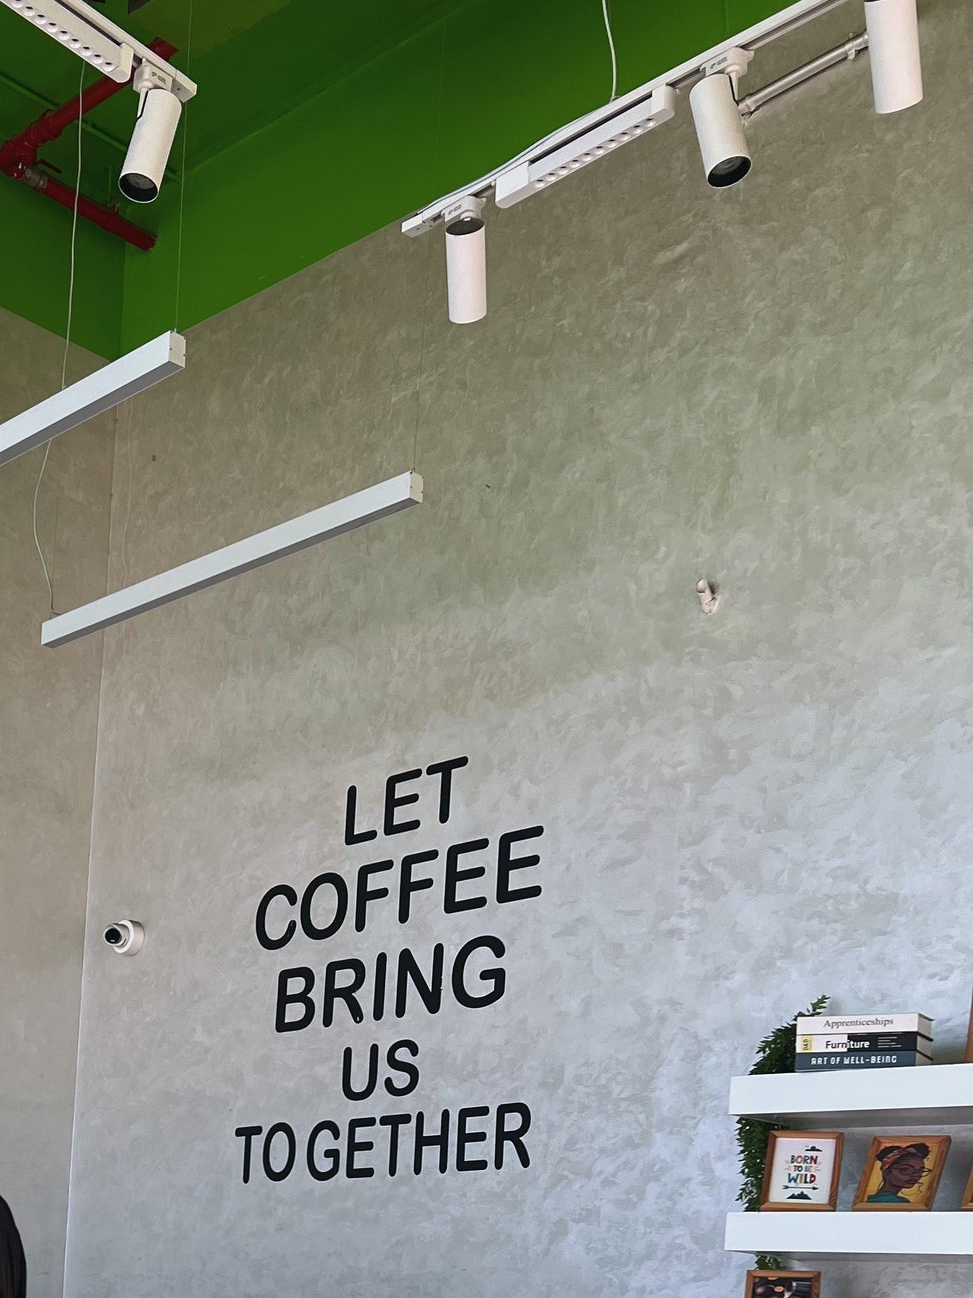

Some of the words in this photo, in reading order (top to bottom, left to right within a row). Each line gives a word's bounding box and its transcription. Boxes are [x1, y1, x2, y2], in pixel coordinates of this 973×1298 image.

[345, 756, 468, 845] LET
[255, 825, 544, 950] COFFEE
[275, 935, 506, 1033] BRING
[823, 1017, 894, 1029] Apprenticeships
[825, 1039, 870, 1050] Furniture
[830, 1057, 840, 1065] OF
[843, 1055, 898, 1065] WELL-BEING
[342, 1039, 420, 1101] US
[235, 1102, 531, 1184] TOGETHER
[790, 1155, 818, 1164] BORN
[787, 1173, 816, 1184] WILD
